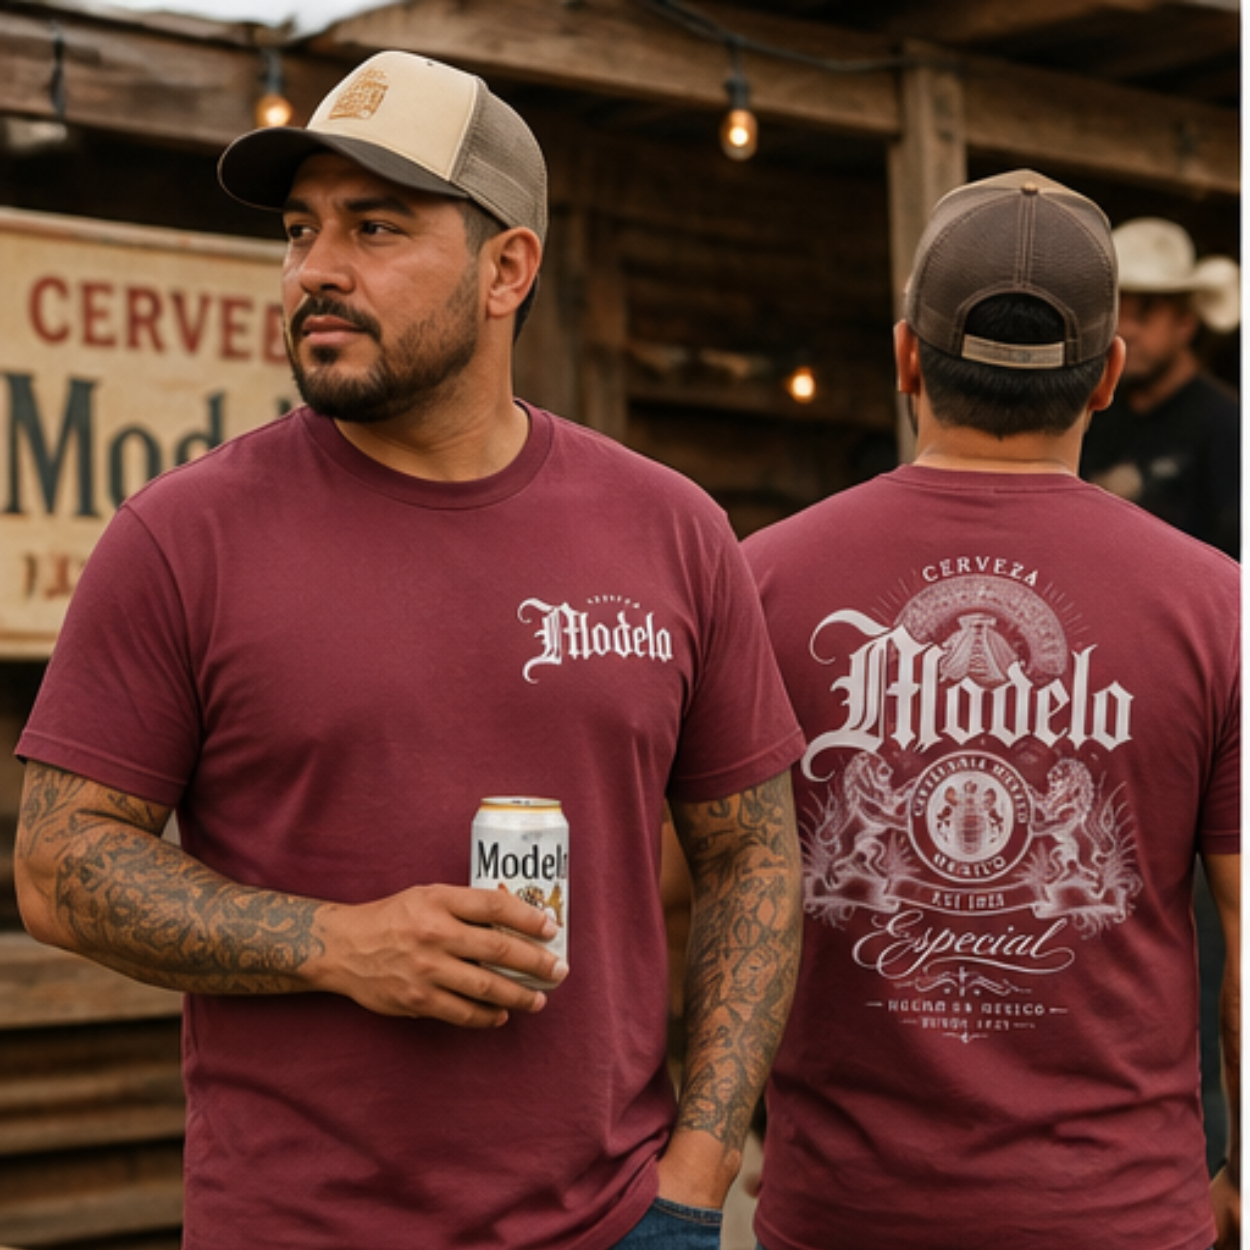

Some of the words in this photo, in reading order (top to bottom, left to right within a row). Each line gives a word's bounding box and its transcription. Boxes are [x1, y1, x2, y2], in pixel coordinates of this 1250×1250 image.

[922, 556, 1039, 587] CERVEZA
[801, 608, 1135, 781] Modelo
[852, 910, 1074, 979] Especial
